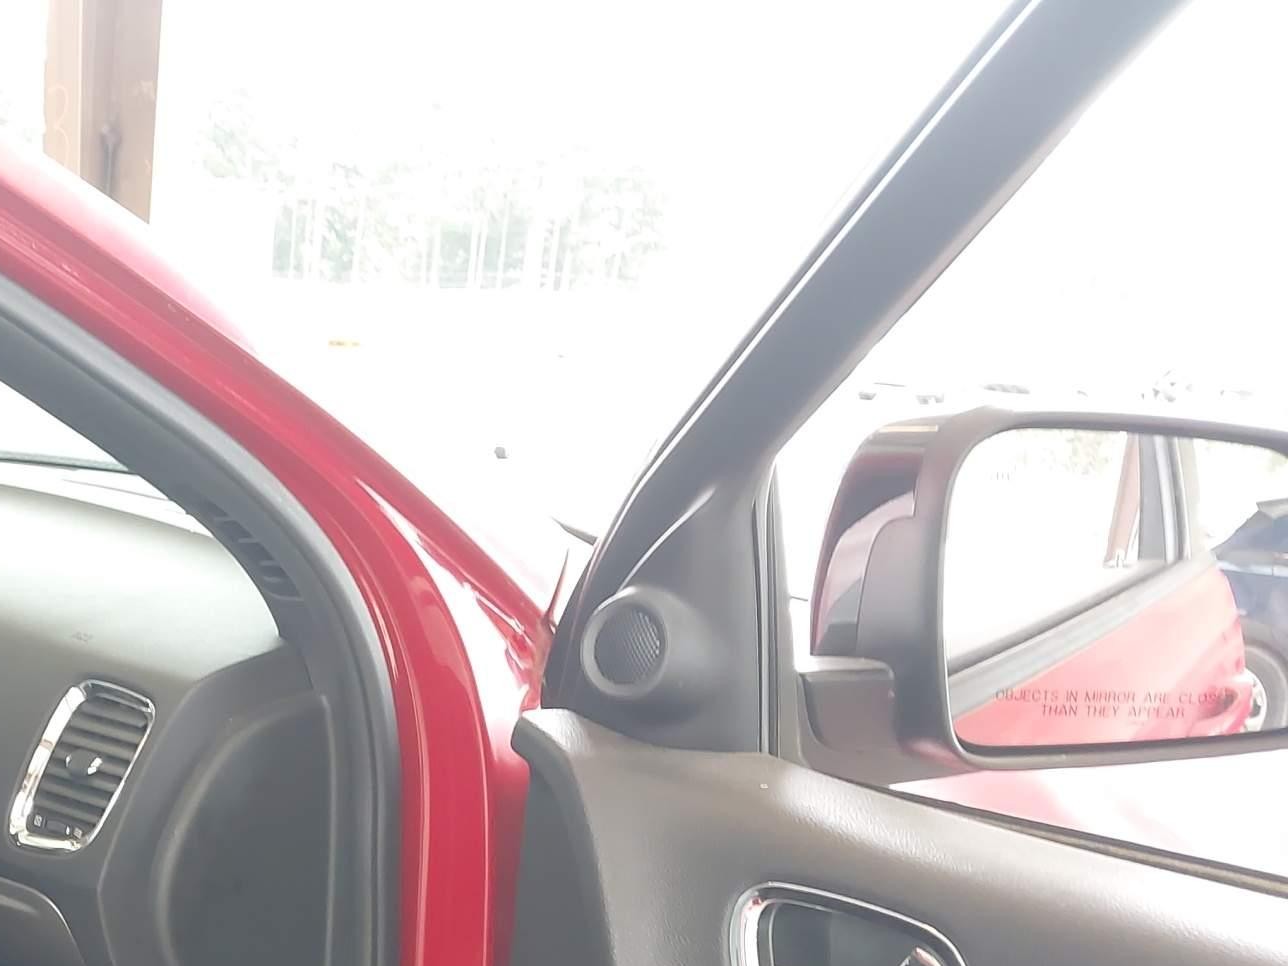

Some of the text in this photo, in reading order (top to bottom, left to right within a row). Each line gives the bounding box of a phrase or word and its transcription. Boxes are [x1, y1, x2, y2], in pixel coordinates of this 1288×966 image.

[995, 688, 1234, 704] OBJECTS IN MIRROR ARE CLOS
[1042, 703, 1186, 719] THAN THEY APPEAR
